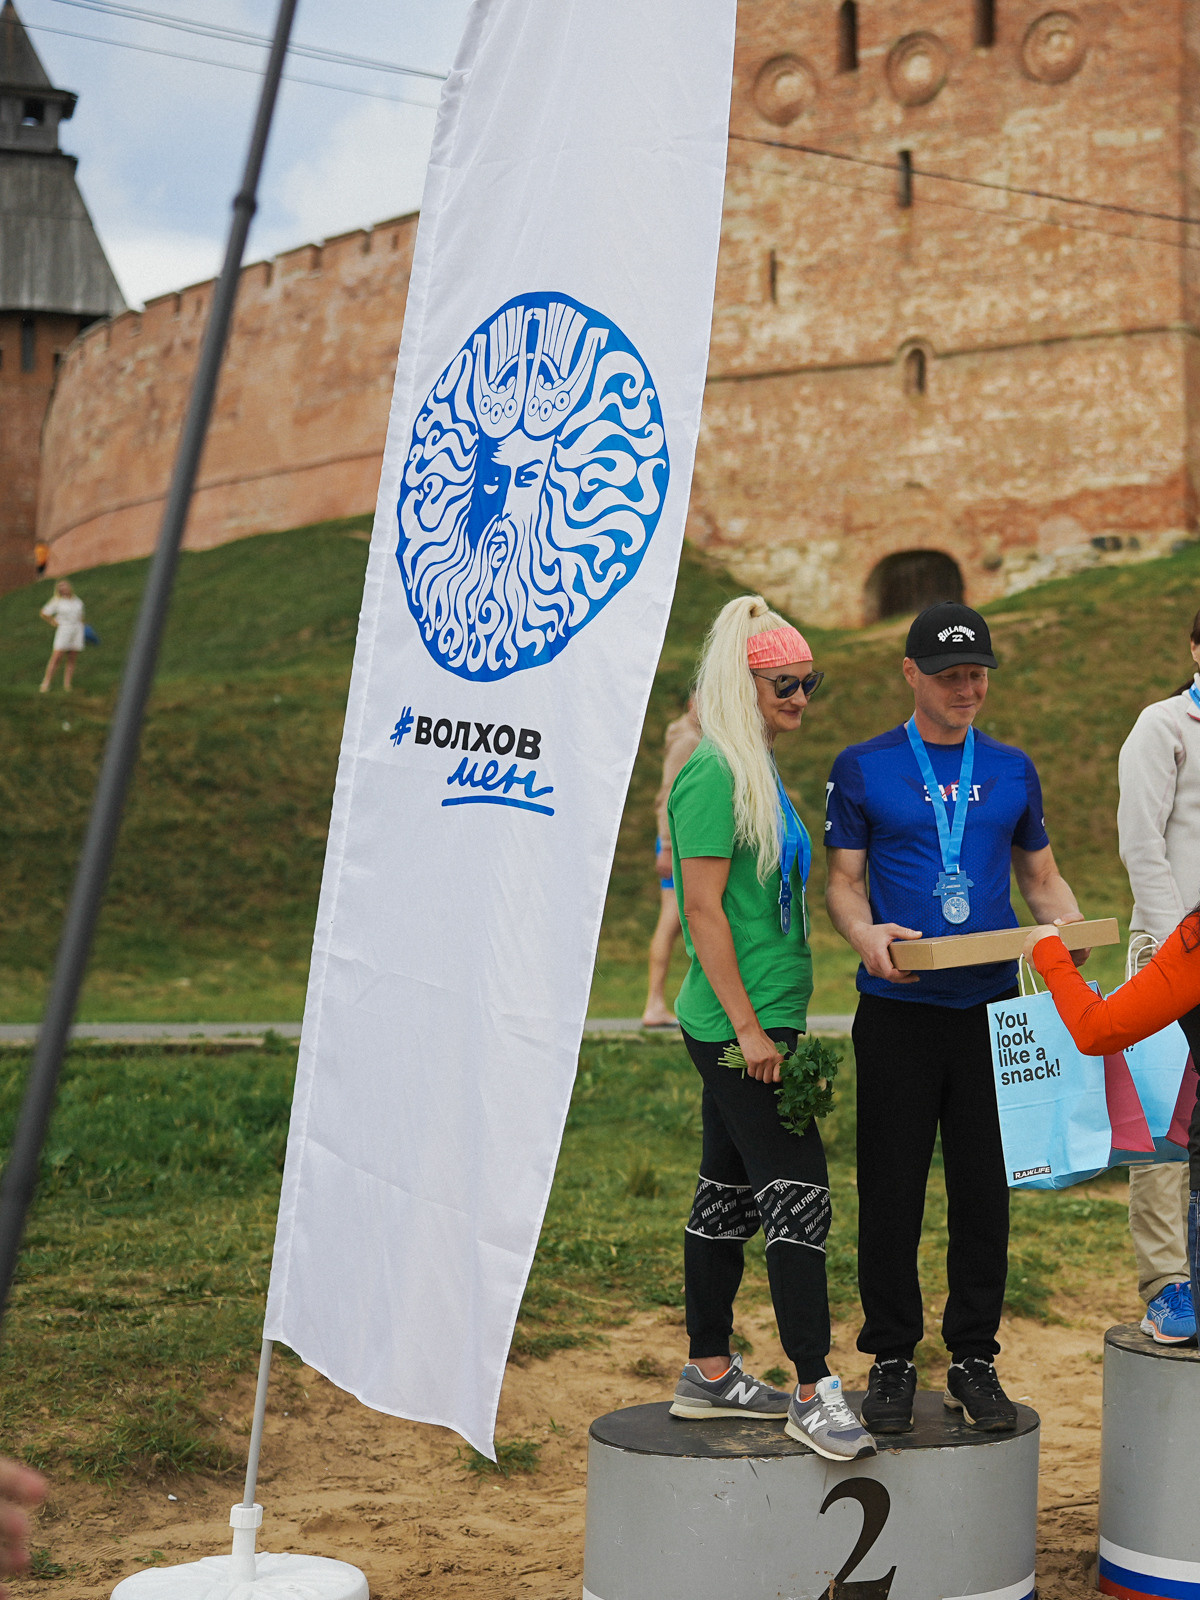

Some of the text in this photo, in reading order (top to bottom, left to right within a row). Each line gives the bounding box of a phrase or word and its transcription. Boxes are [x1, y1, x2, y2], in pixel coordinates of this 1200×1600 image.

[390, 706, 542, 760] #ВОЛХОВ
[994, 1012, 1028, 1030] You
[997, 1027, 1036, 1049] look
[998, 1047, 1046, 1067] like a
[1001, 1059, 1061, 1086] snack!
[818, 1477, 898, 1600] 2
